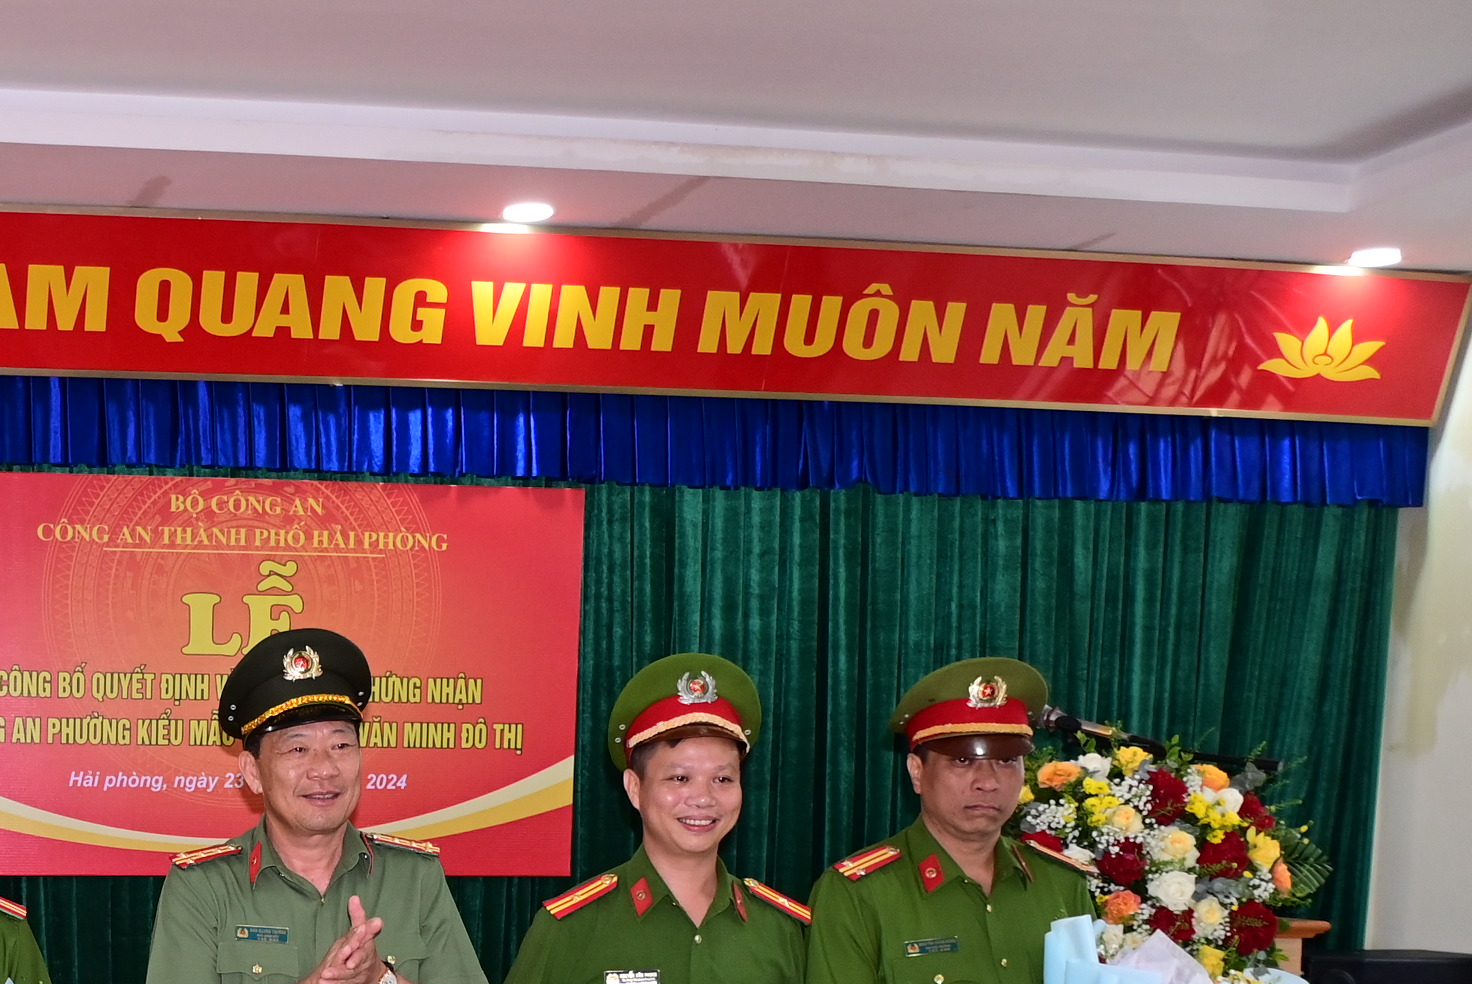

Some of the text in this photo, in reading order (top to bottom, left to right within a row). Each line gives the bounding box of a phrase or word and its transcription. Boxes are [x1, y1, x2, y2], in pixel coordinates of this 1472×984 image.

[133, 266, 449, 344] QUANG
[470, 280, 682, 352] VINH
[696, 282, 967, 364] MUÔN
[978, 292, 1182, 373] NĂM
[169, 490, 325, 517] BỘ CÔNG AN
[36, 517, 449, 552] CÔNG AN THÀNH PHỐ HẢI PHÒNG
[180, 560, 305, 657] LỄ
[58, 662, 88, 698] BỐ
[92, 664, 157, 702] QUYẾT
[161, 672, 210, 706] ĐỊNH
[369, 671, 422, 703] HỨNG
[427, 672, 483, 710] NHẬN
[11, 715, 42, 745] AN
[47, 710, 131, 746] PHƯỜNG
[137, 709, 184, 746] KIỂU
[359, 716, 399, 748] VĂN
[403, 722, 456, 749] MINH
[460, 717, 488, 749] ĐÔ
[493, 722, 524, 755] THỊ
[68, 770, 99, 788] Hải
[103, 772, 168, 792] phòng,
[173, 772, 220, 793] ngày
[366, 773, 409, 791] 2024
